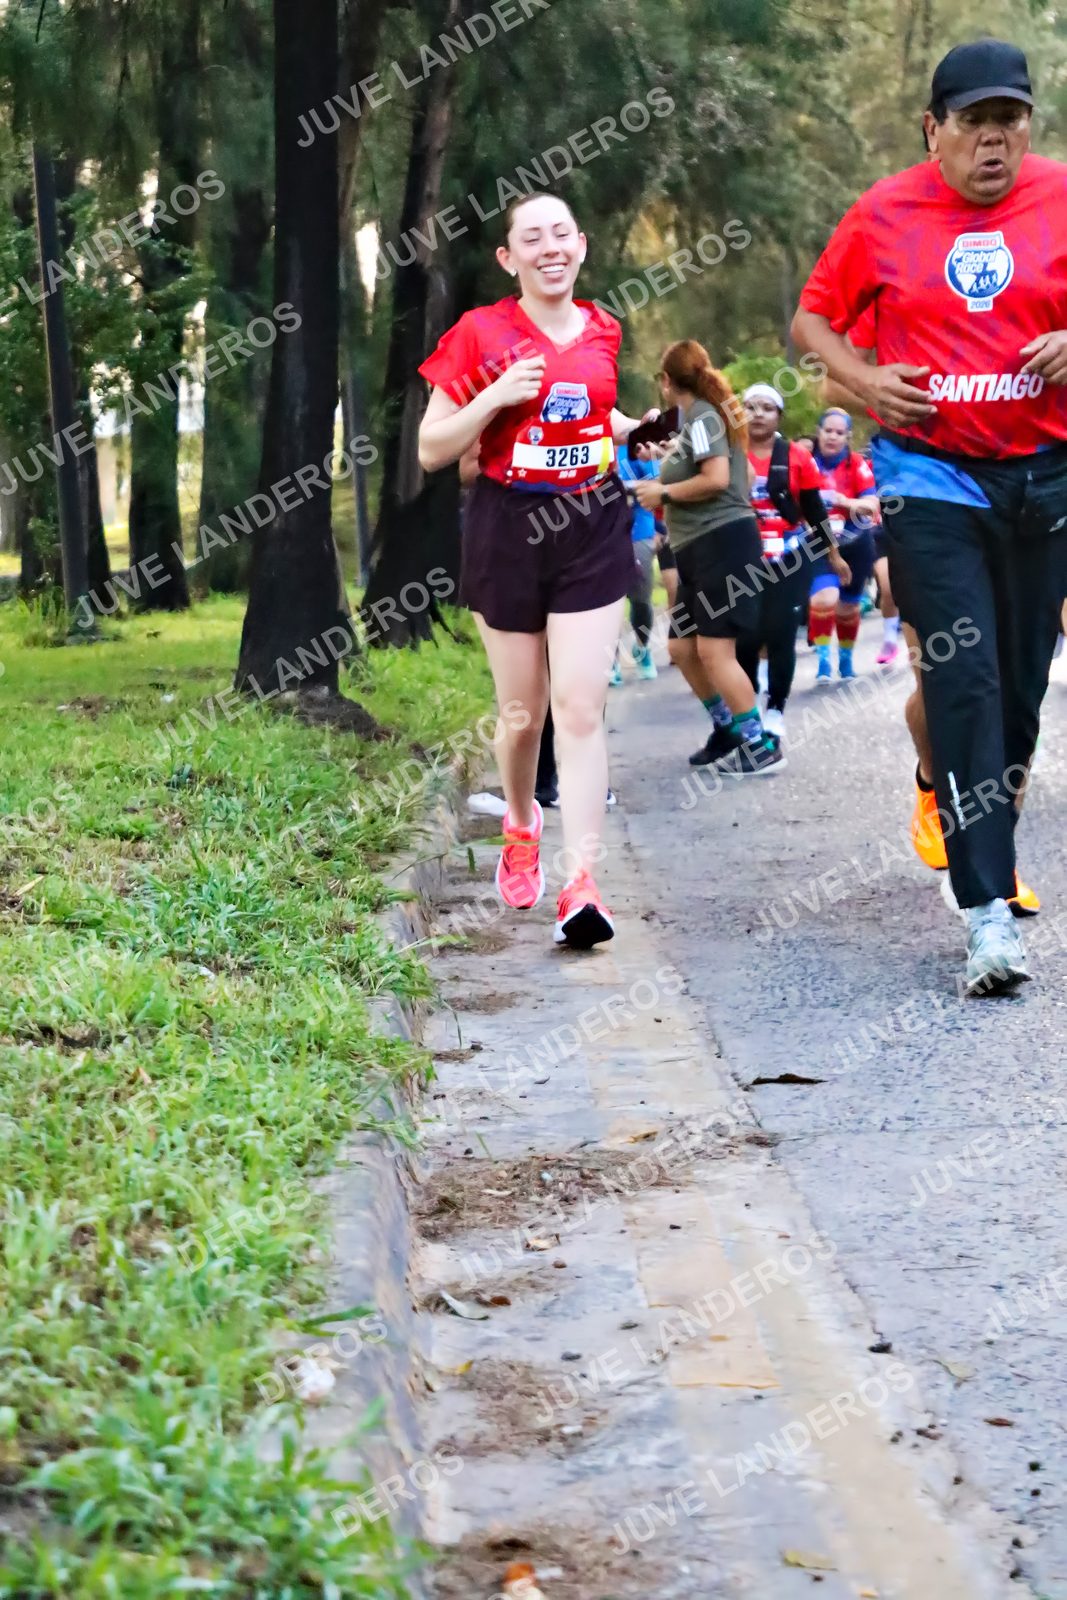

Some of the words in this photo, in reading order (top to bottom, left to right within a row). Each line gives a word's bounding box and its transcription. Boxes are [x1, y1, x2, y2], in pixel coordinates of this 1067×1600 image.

[962, 251, 997, 263] Global
[956, 262, 984, 274] Race
[928, 372, 1044, 402] SANTIAGO
[545, 445, 589, 467] 3263
